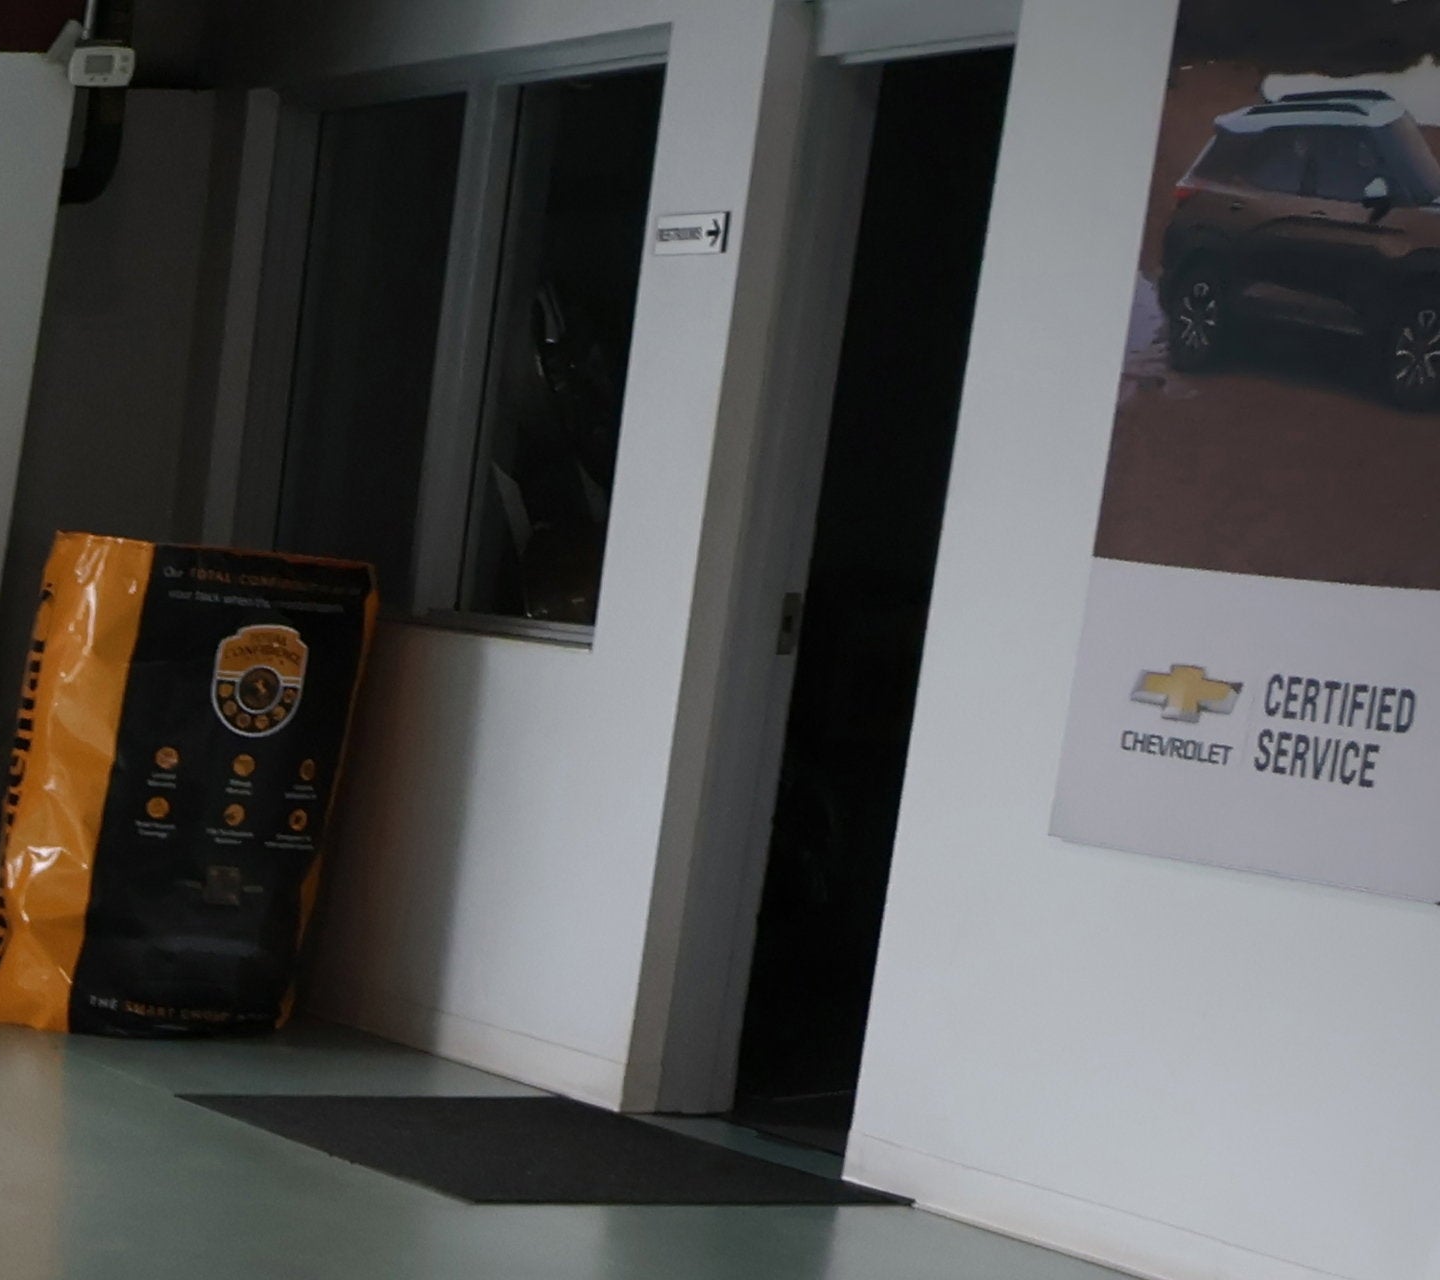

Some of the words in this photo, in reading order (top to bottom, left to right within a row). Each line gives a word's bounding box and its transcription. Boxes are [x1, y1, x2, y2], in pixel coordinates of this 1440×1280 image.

[1264, 673, 1416, 734] CERTIFIED
[1121, 730, 1234, 766] CHEVROLET
[1253, 728, 1380, 788] SERVICE
